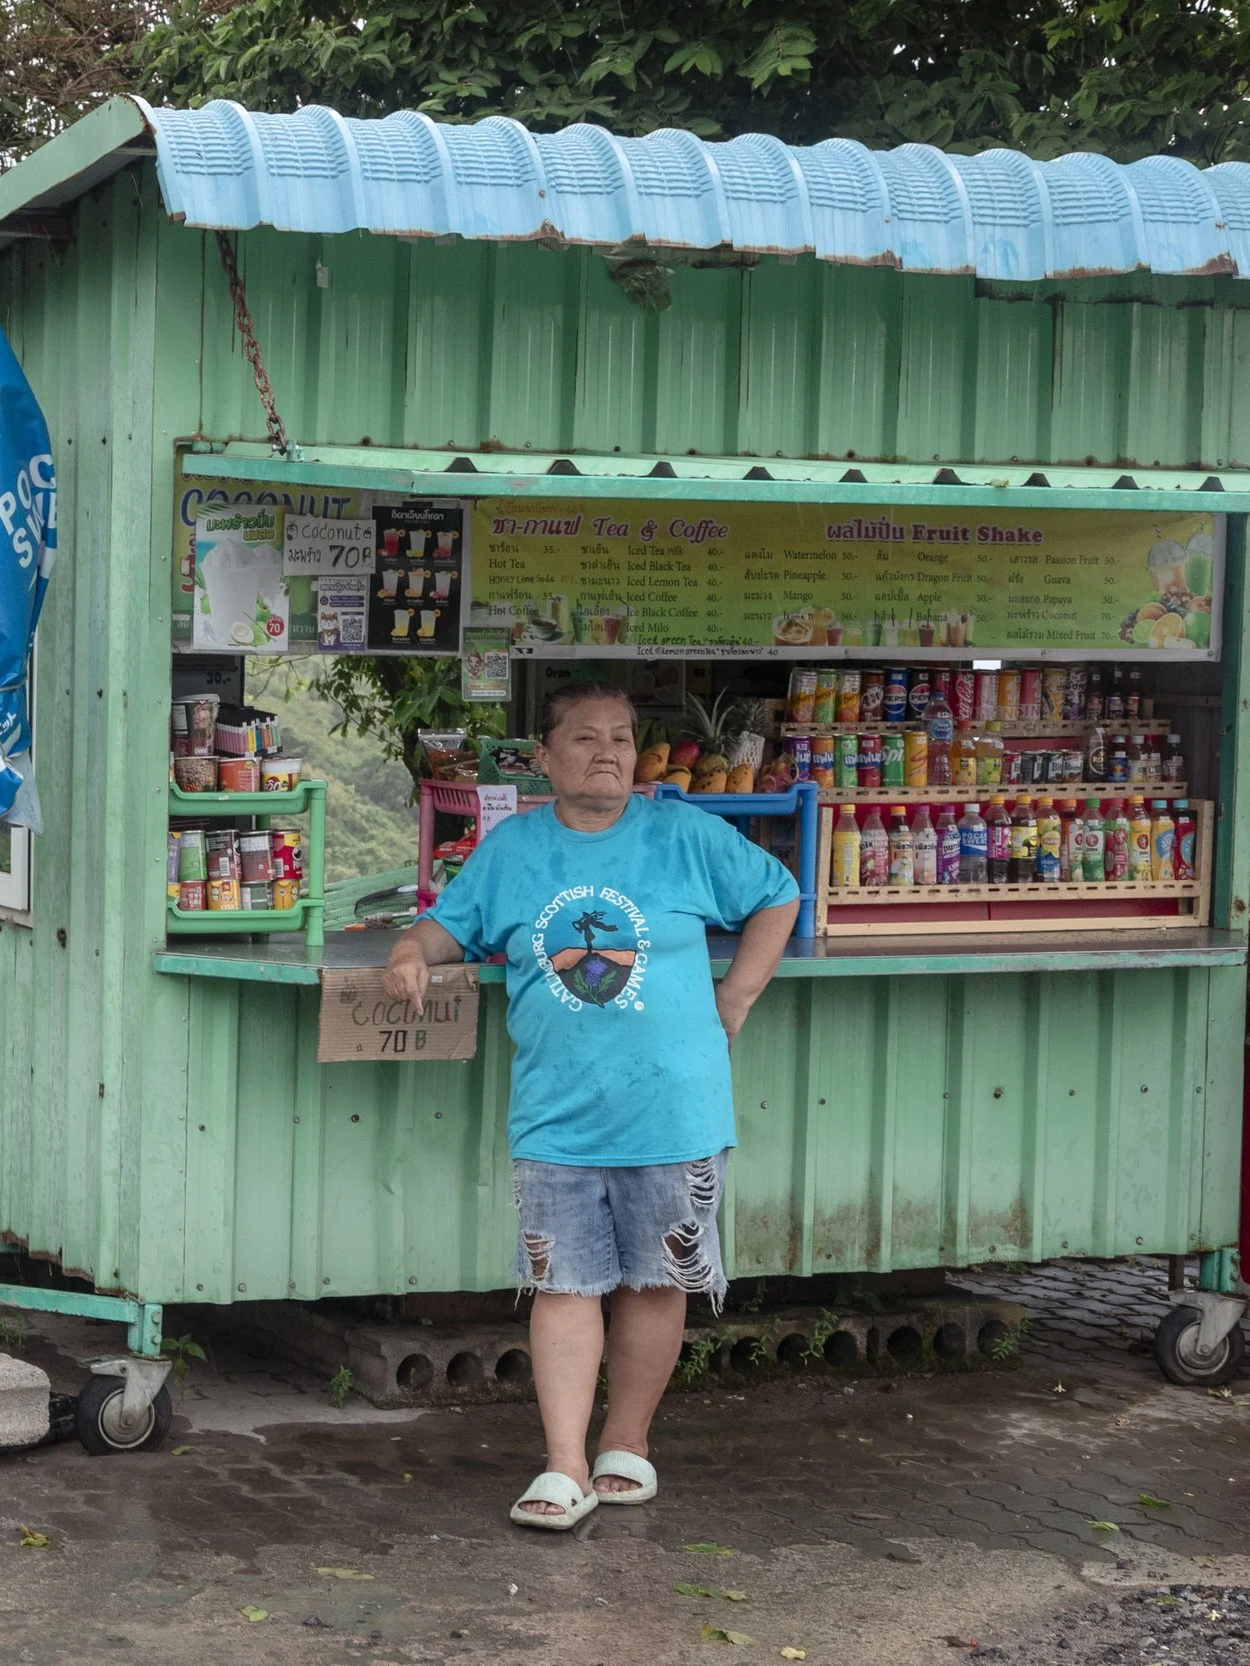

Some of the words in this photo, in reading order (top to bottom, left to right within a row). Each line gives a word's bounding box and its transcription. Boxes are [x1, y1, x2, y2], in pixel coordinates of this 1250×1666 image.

[492, 515, 582, 535] ชา-กาแฟ
[593, 518, 629, 537] Tea
[641, 520, 658, 542] &
[669, 519, 729, 543] Coffee
[827, 517, 904, 540] ผลไม้ปั่น
[911, 524, 970, 541] Fruit
[977, 526, 1043, 543] Shake
[489, 541, 518, 553] ชาร้อน
[581, 543, 609, 554] ชาเย็น
[628, 545, 646, 555] Iced
[650, 545, 664, 555] Tea
[744, 547, 773, 560] แตงโม
[783, 549, 837, 560] Watermelon
[917, 552, 948, 565] Orange
[1045, 555, 1076, 564] Passion
[1079, 555, 1099, 564] Fruit
[489, 558, 506, 568] Hot
[510, 558, 525, 568] Tea
[628, 560, 646, 571] Iced
[649, 560, 673, 571] Black
[676, 561, 691, 571] Tea
[627, 576, 646, 586] Iced
[649, 576, 680, 586] Lemon
[682, 576, 698, 587] Tea
[783, 569, 826, 582] Pineapple
[917, 572, 949, 584] Dragon
[952, 572, 972, 582] Fruit
[1044, 574, 1070, 584] Guava
[626, 591, 645, 602] Iced
[648, 591, 678, 602] Coffee
[783, 590, 813, 602] Mango
[917, 592, 942, 604] Apple
[1043, 594, 1072, 606] Papaya
[489, 605, 507, 616] Hot
[509, 605, 539, 616] Coffee
[626, 607, 639, 617] Ice
[642, 607, 667, 617] Black
[668, 607, 698, 617] Coffee
[1042, 610, 1077, 620] Coconut
[269, 623, 281, 633] 70
[626, 622, 645, 632] Iced
[648, 622, 669, 632] Milo
[1047, 630, 1073, 639] Mixed
[1075, 630, 1095, 640] Fruit
[535, 885, 594, 929] SCOTTISH
[599, 886, 649, 937] FESTIVAL
[637, 940, 651, 950] &
[614, 953, 647, 1009] GAMES
[379, 1030, 408, 1053] 70
